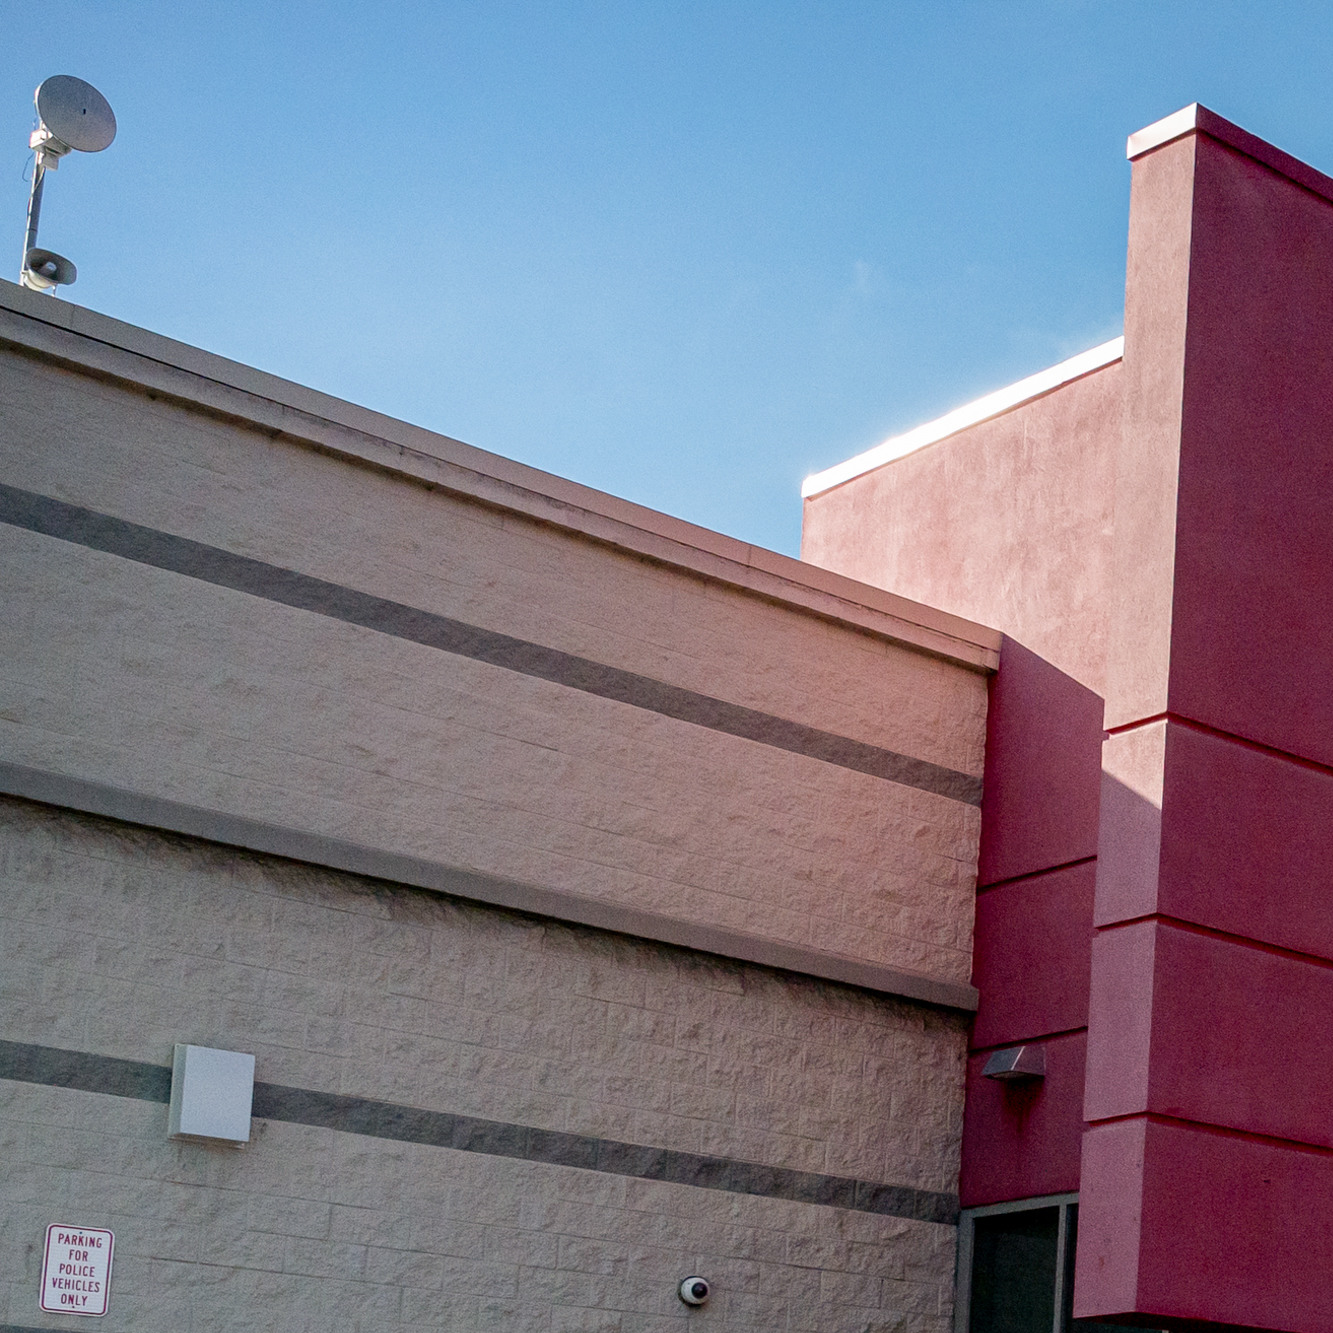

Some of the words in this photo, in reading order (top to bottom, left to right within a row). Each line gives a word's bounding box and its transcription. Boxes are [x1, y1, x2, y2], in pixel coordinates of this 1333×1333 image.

[58, 1233, 102, 1248] PARKING
[69, 1249, 88, 1262] FOR
[59, 1263, 95, 1277] POLICE
[52, 1278, 100, 1293] VEHICLES
[61, 1293, 88, 1306] ONLY
